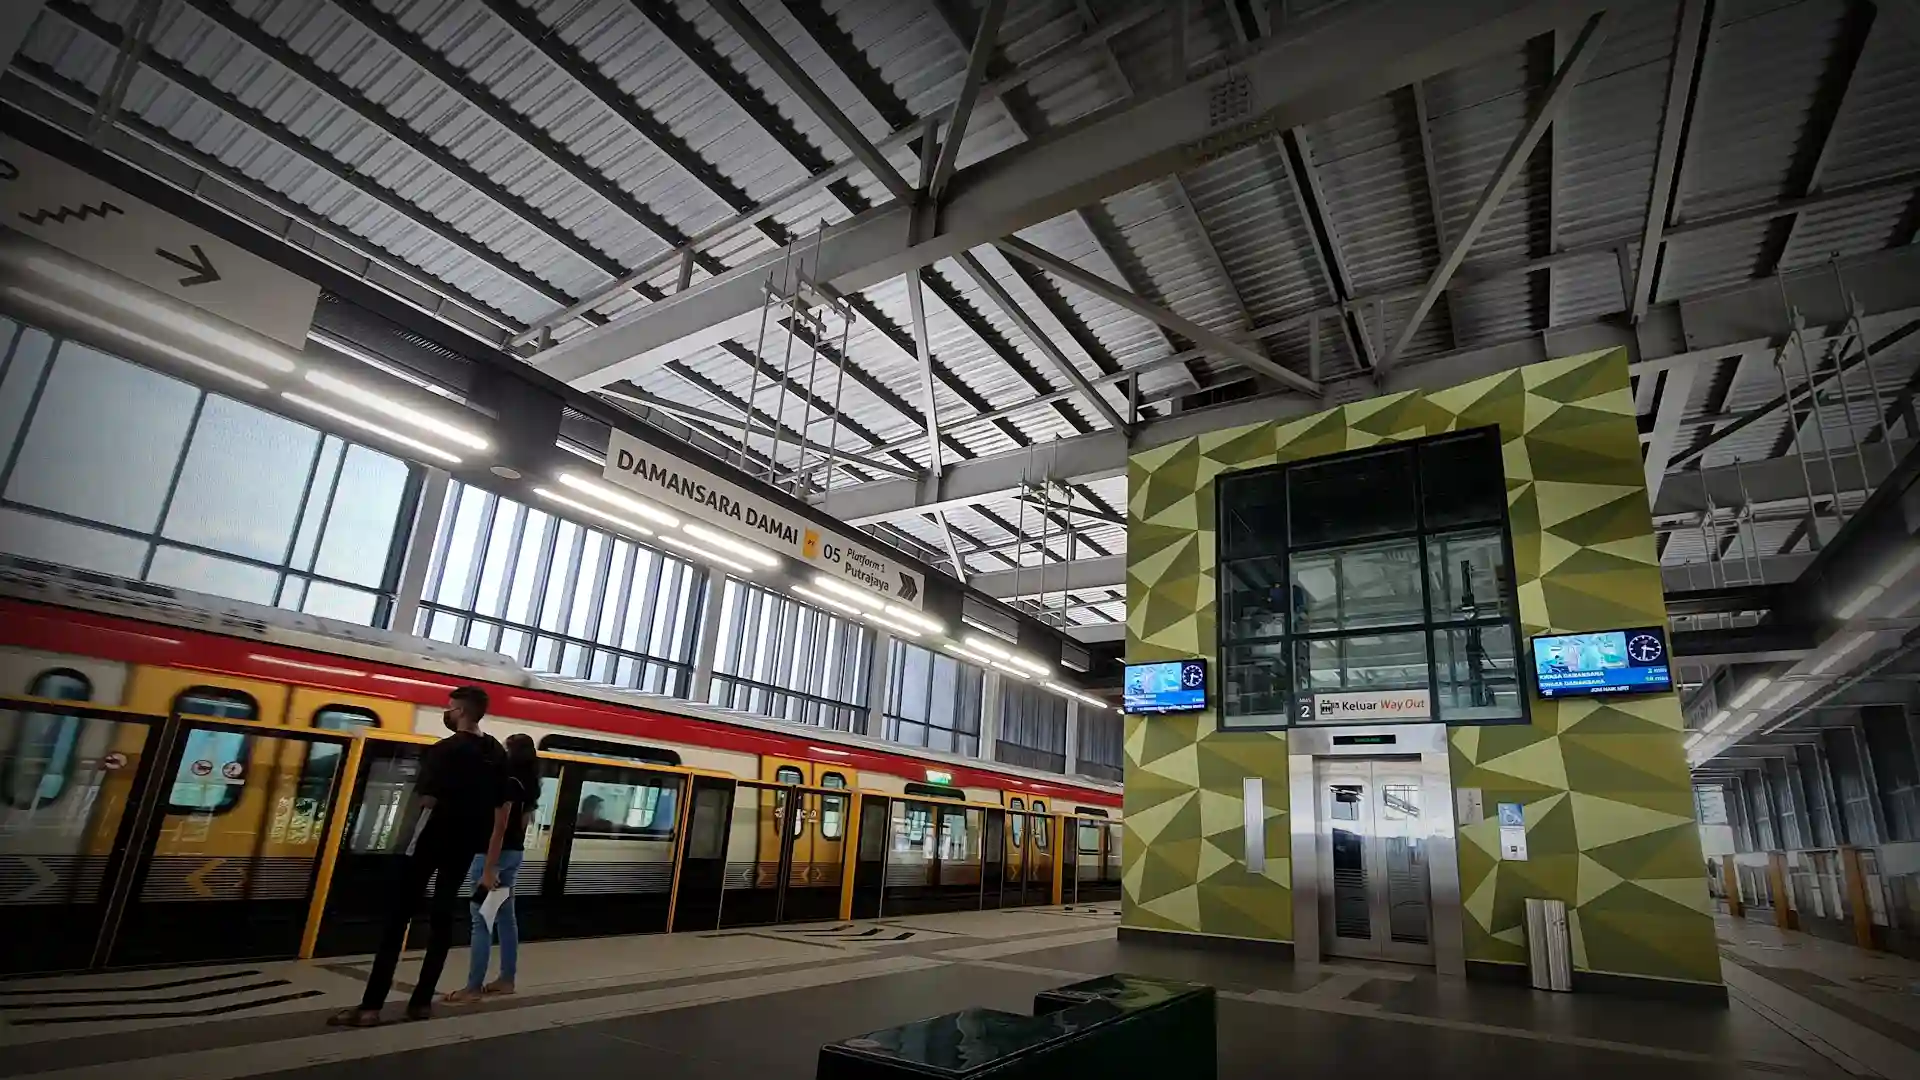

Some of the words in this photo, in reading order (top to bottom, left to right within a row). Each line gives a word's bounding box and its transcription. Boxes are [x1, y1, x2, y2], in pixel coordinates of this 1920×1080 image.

[616, 448, 742, 520] DAMANSARA
[745, 507, 799, 546] DAMAI
[823, 543, 841, 563] 05
[846, 548, 880, 571] Platform
[881, 564, 885, 573] 1
[844, 562, 889, 591] Putrajaya
[1300, 705, 1310, 718] 2
[1342, 701, 1377, 711] Keluar
[1380, 699, 1403, 711] Way
[1404, 698, 1424, 709] Out
